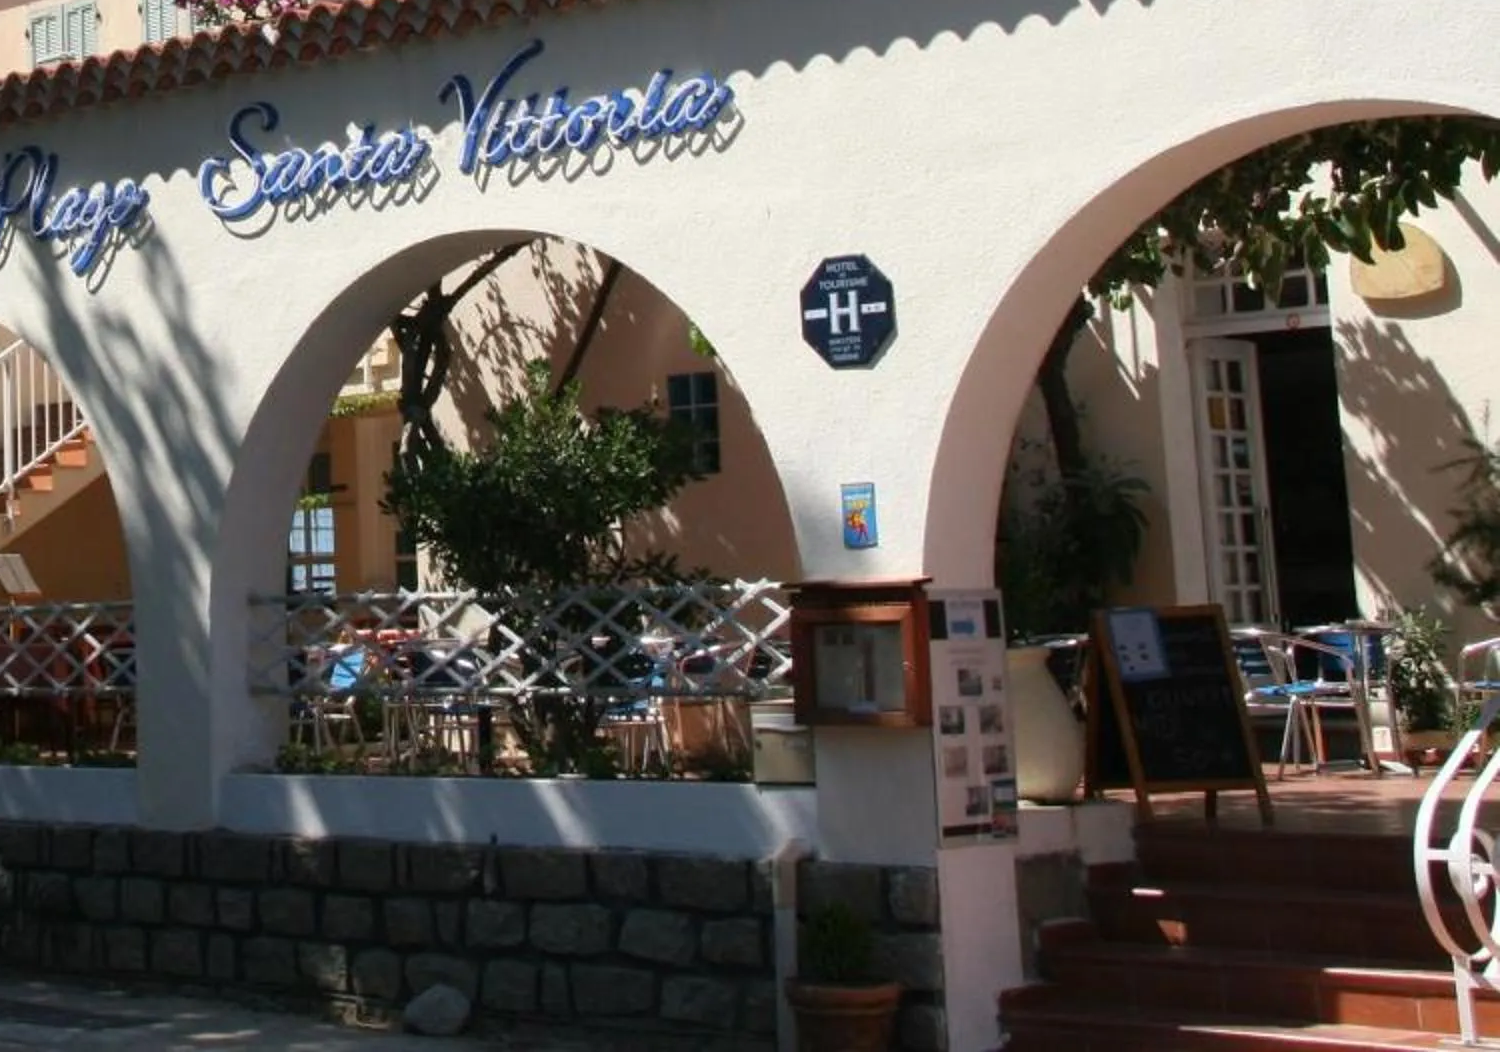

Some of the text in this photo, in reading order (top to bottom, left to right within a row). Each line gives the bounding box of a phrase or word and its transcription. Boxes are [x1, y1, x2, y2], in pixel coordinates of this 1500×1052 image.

[201, 101, 433, 221] Santa
[438, 39, 738, 177] Vittoria
[828, 290, 860, 334] H
